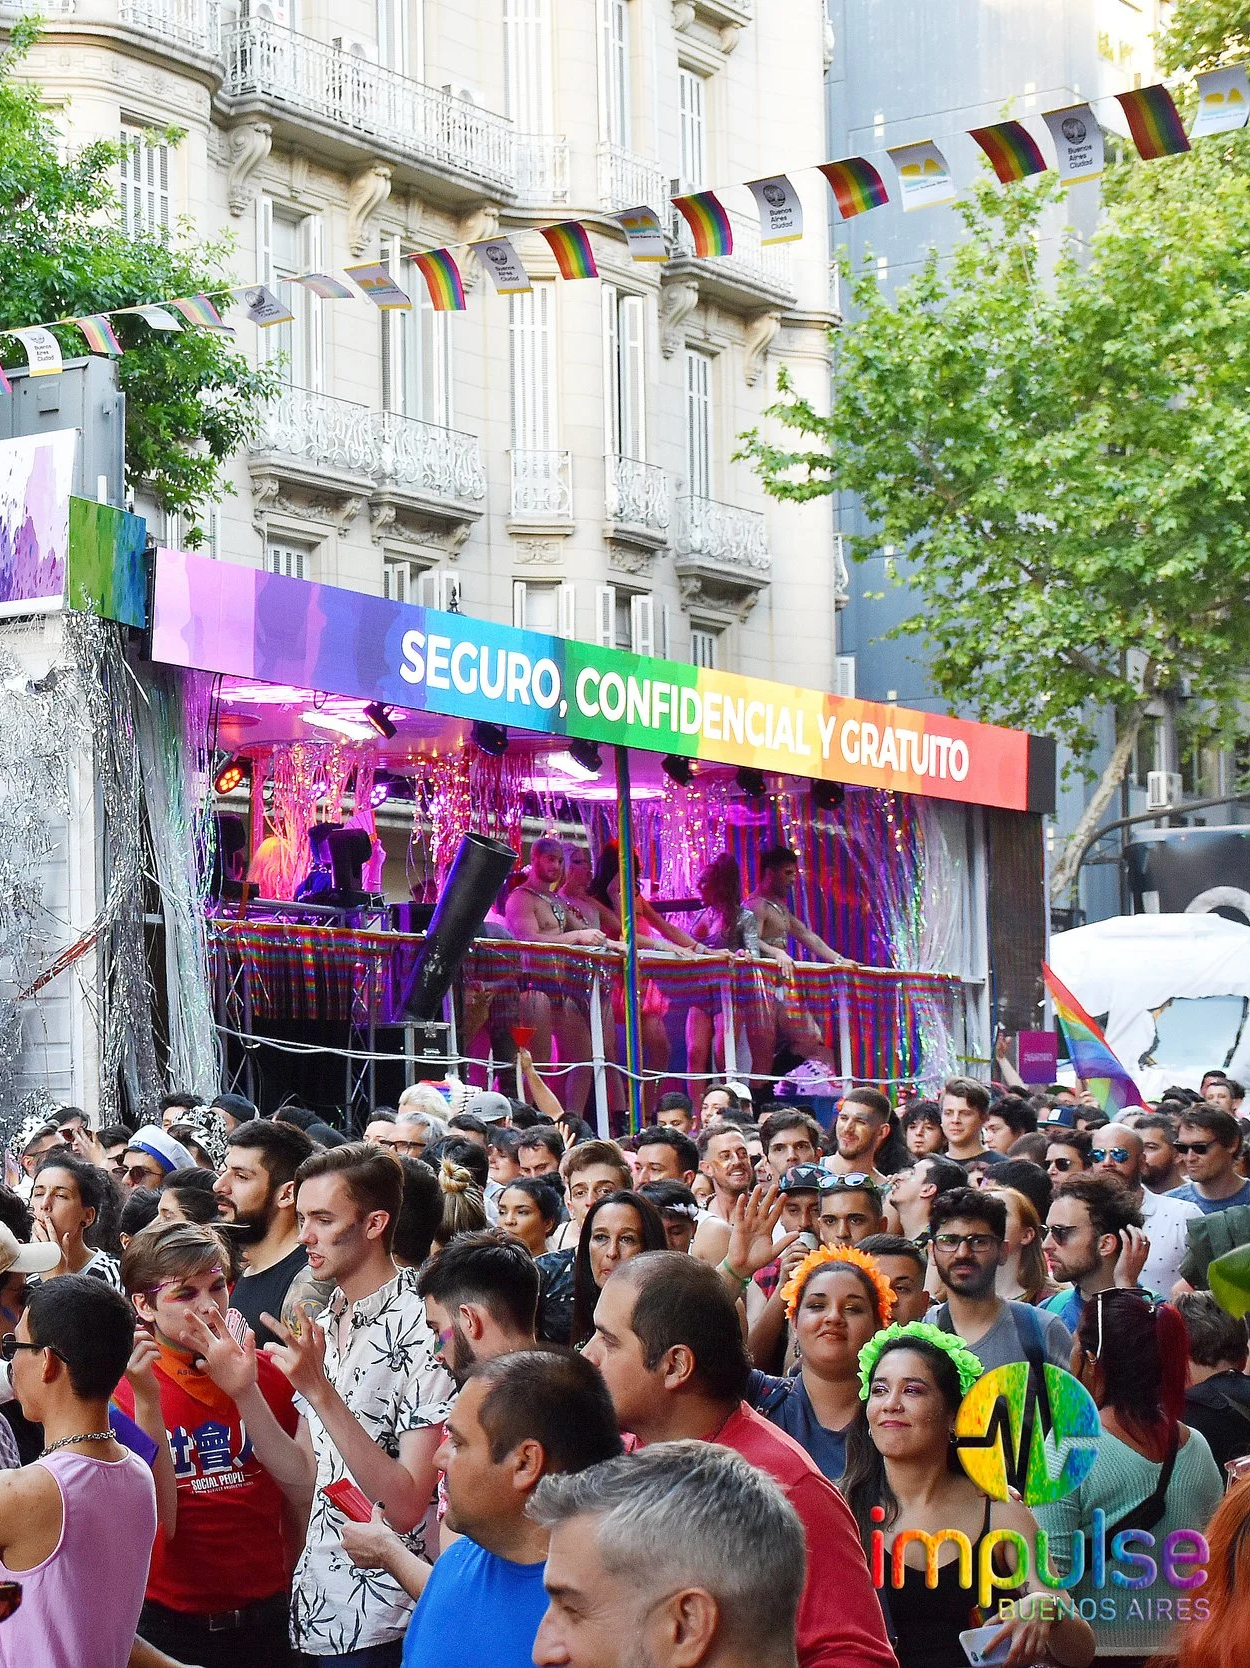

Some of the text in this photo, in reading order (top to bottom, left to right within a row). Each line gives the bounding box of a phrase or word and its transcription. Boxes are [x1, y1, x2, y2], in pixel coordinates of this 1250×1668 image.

[1068, 145, 1092, 155] Buenos
[1069, 153, 1087, 162] Aires
[1069, 158, 1093, 169] Ciudad
[769, 208, 792, 217] Buenos
[771, 221, 793, 230] Ciudad
[399, 629, 970, 783] SEGURO, CONFIDENCIAL Y GRATUITO
[190, 1475, 220, 1491] SOCIAL
